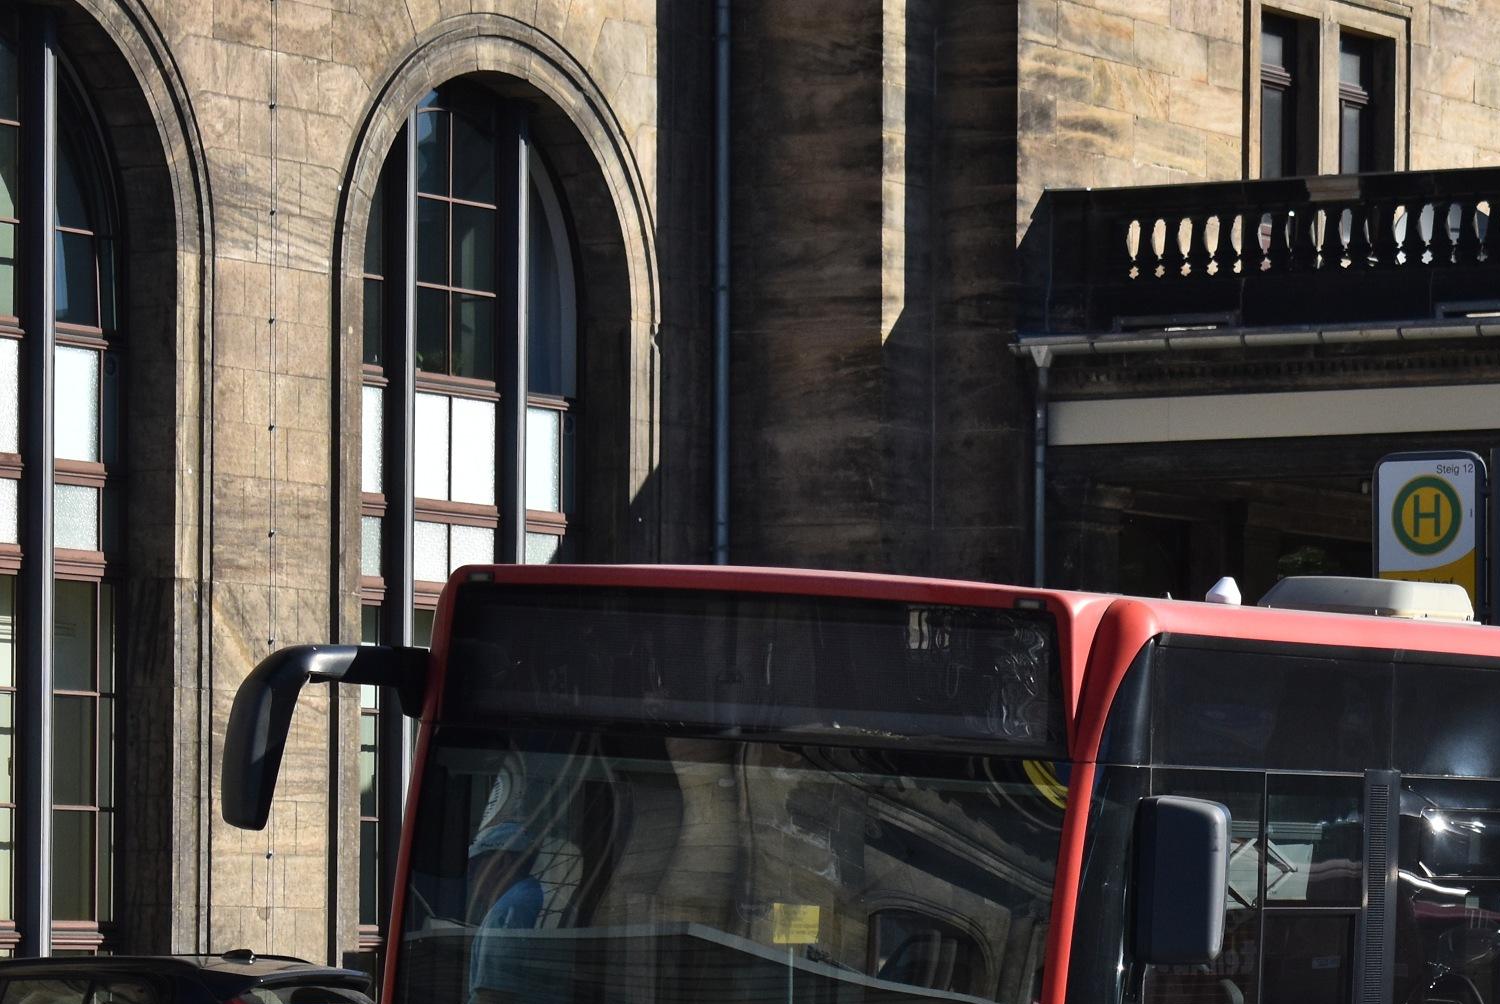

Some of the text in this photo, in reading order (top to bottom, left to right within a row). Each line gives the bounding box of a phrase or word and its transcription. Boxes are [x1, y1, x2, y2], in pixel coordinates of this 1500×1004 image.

[1436, 463, 1474, 476] Steig 12
[1413, 494, 1441, 538] H
